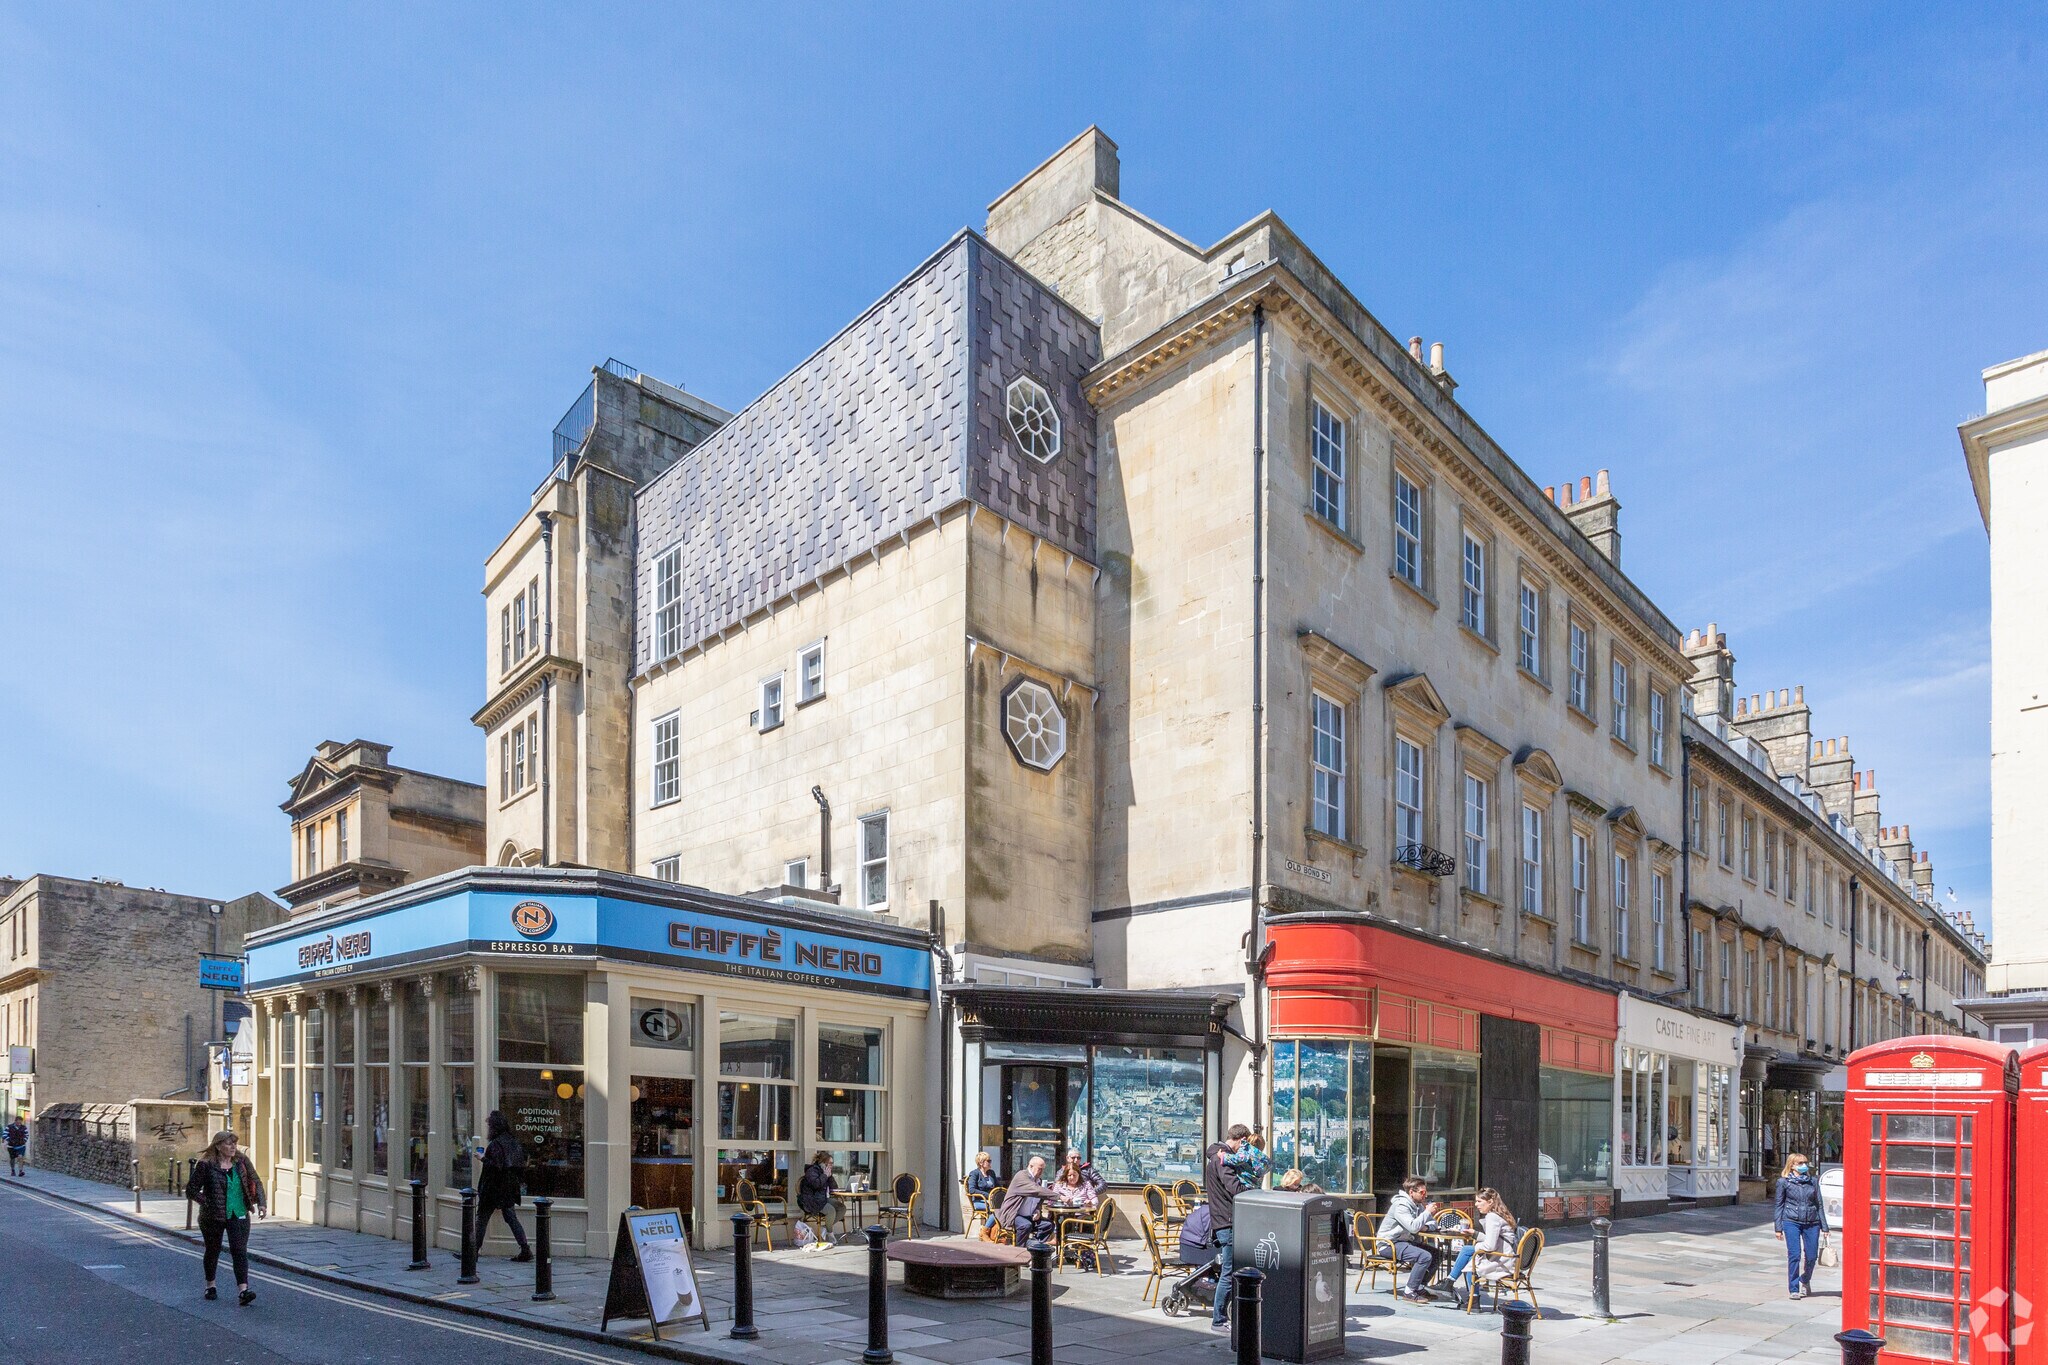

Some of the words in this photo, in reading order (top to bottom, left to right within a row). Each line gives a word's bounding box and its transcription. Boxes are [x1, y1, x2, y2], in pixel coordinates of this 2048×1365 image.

[1287, 861, 1301, 872] OLD
[1303, 866, 1320, 878] BOND
[524, 911, 539, 924] N
[298, 934, 334, 968] CAFFÈ
[336, 931, 372, 961] NERO
[491, 942, 547, 953] ESPRESSO
[552, 944, 574, 954] BAR
[668, 922, 782, 962] CAFFÈ
[796, 942, 882, 976] NERO
[202, 972, 239, 982] NERO
[725, 963, 743, 974] THE
[747, 966, 783, 979] ITALIAN
[786, 972, 820, 984] COFFEE
[963, 1012, 979, 1023] 12A
[1655, 1017, 1684, 1040] CASTLE
[1686, 1025, 1701, 1045] FINE
[1702, 1030, 1716, 1048] ART
[517, 1108, 561, 1116] ADDITIONAL
[524, 1116, 555, 1124] SEATING
[515, 1124, 563, 1133] DOWNSTAIRS
[640, 1225, 674, 1236] NERO
